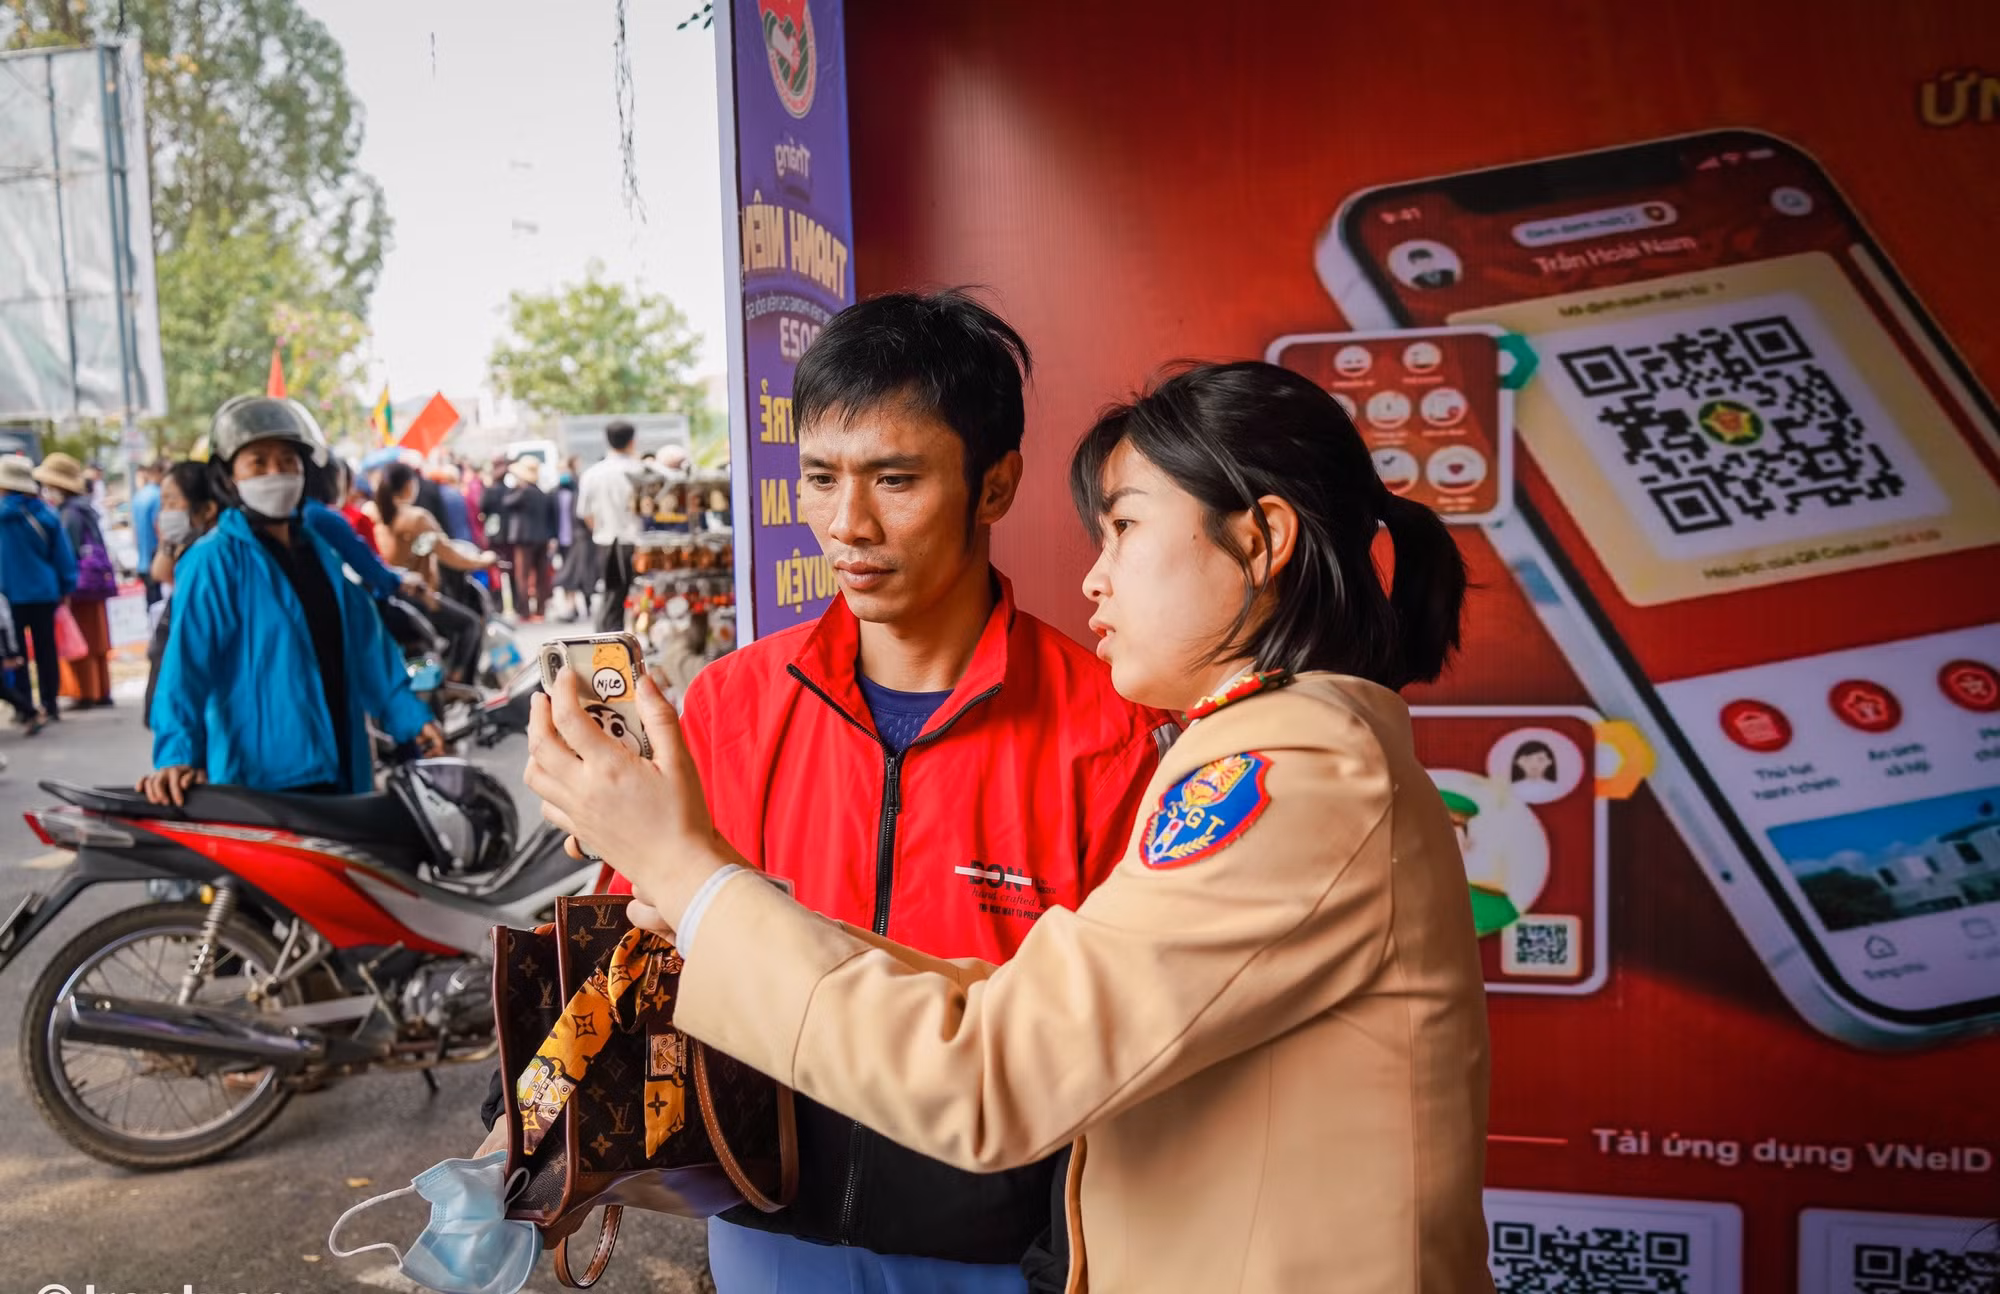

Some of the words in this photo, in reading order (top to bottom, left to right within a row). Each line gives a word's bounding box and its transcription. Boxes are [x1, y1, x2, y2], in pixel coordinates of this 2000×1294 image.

[999, 893, 1037, 909] crafted
[1592, 1128, 1650, 1156] Tải
[1662, 1132, 1740, 1167] ứng
[1753, 1138, 1853, 1172] dụng
[1866, 1142, 1992, 1174] VNeID
